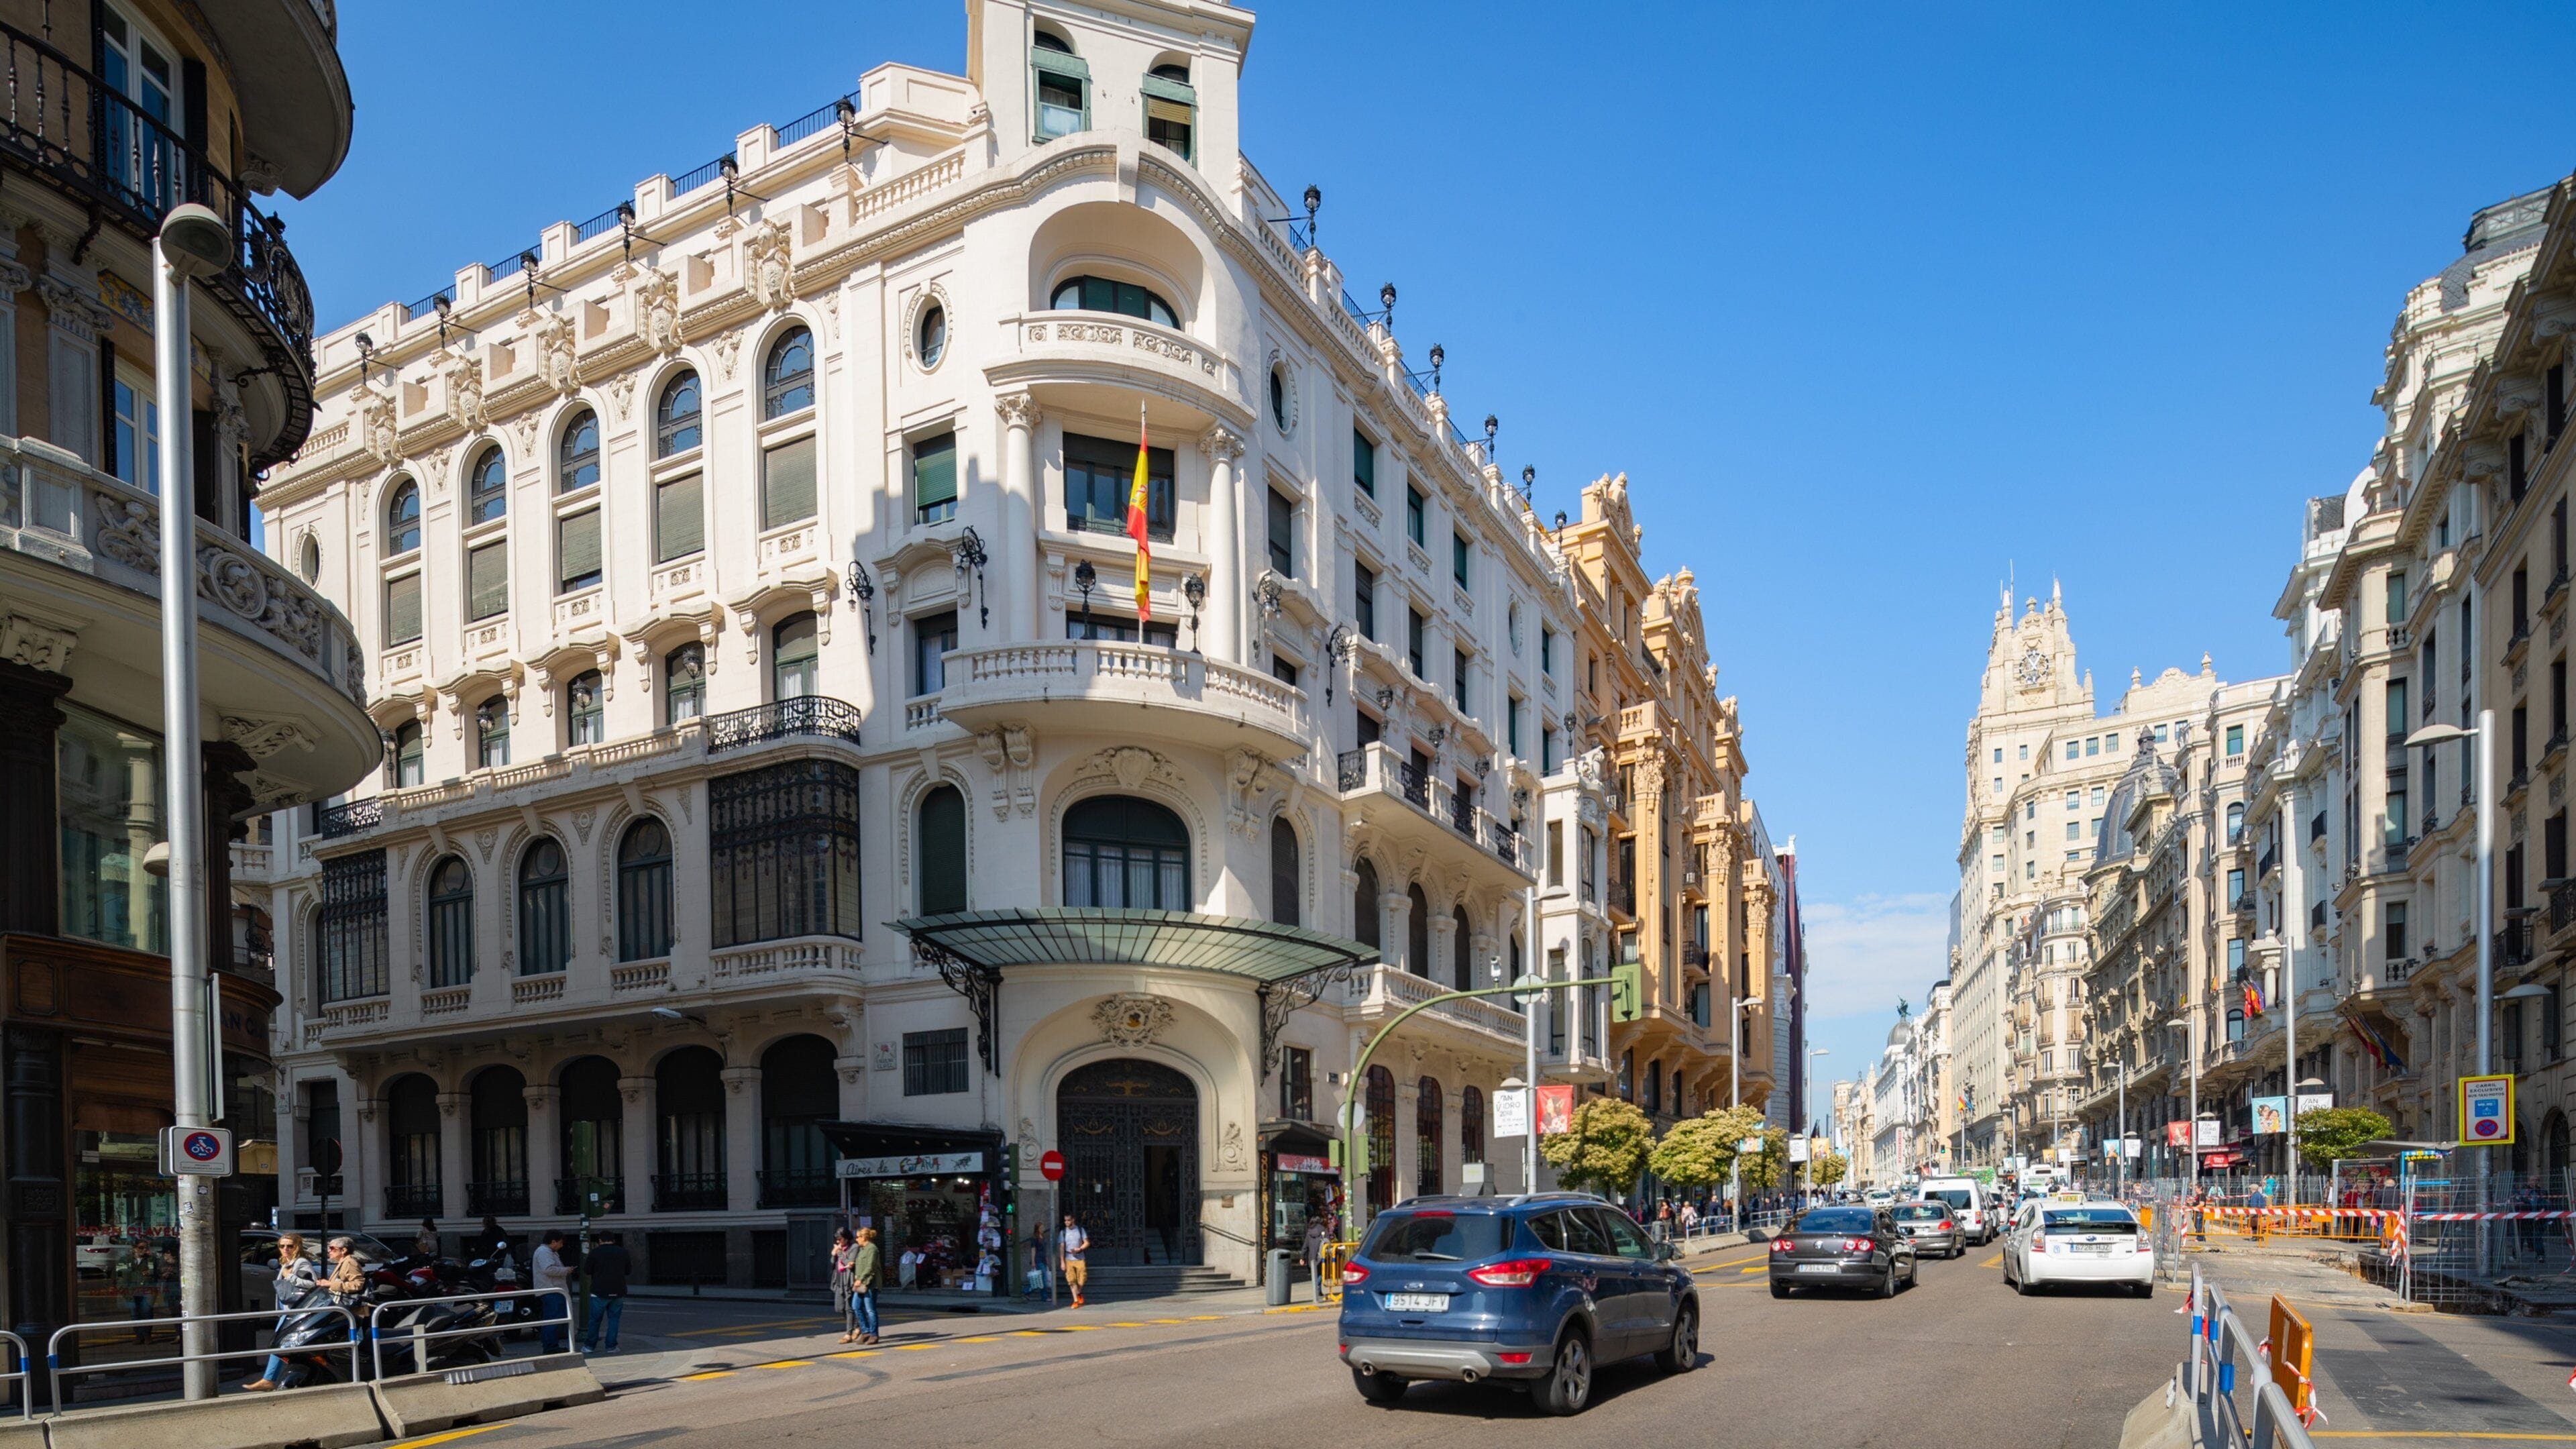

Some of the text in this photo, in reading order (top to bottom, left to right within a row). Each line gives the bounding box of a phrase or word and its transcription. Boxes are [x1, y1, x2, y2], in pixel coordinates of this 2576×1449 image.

[76, 1226, 180, 1238] GRAN CLAVEL
[1393, 1294, 1446, 1307] 9514 JFV
